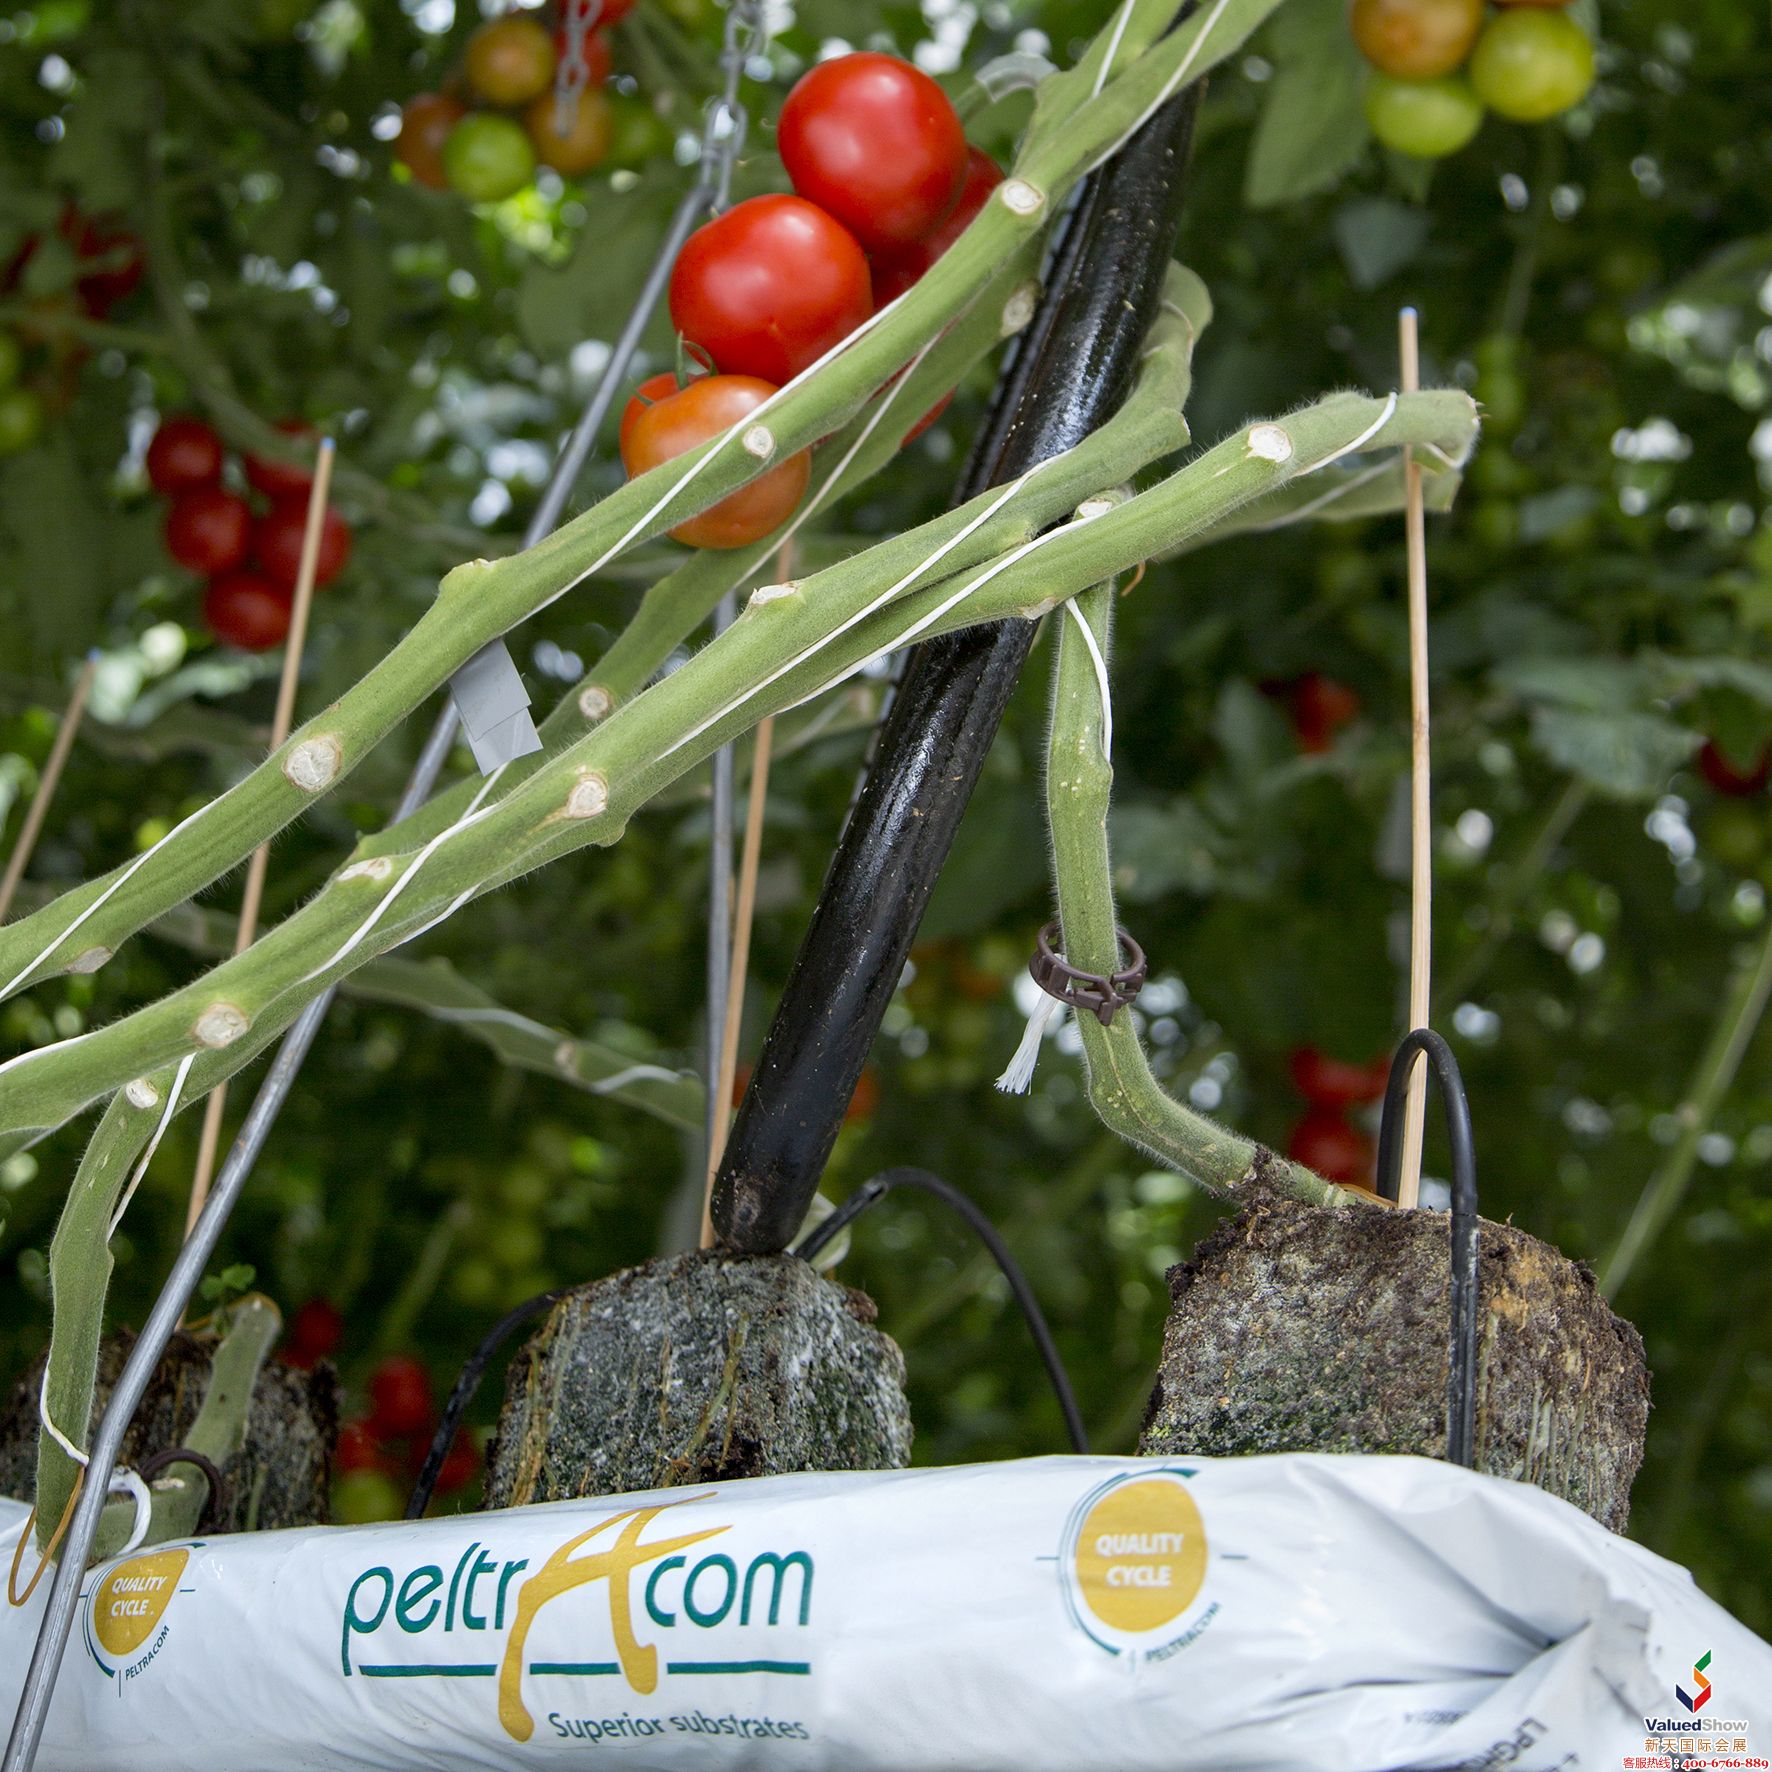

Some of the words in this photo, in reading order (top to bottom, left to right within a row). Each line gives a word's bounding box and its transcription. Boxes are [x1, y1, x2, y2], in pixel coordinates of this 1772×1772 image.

[1094, 1532, 1184, 1557] QUALITY
[111, 1575, 167, 1594] QUALITY
[1105, 1566, 1173, 1587] CYCLE
[110, 1599, 149, 1617] CYCLE
[1145, 1601, 1221, 1664] PELTRACOM
[124, 1624, 170, 1681] PELTRACOM
[548, 1712, 665, 1743] Superior
[669, 1710, 810, 1741] substrates
